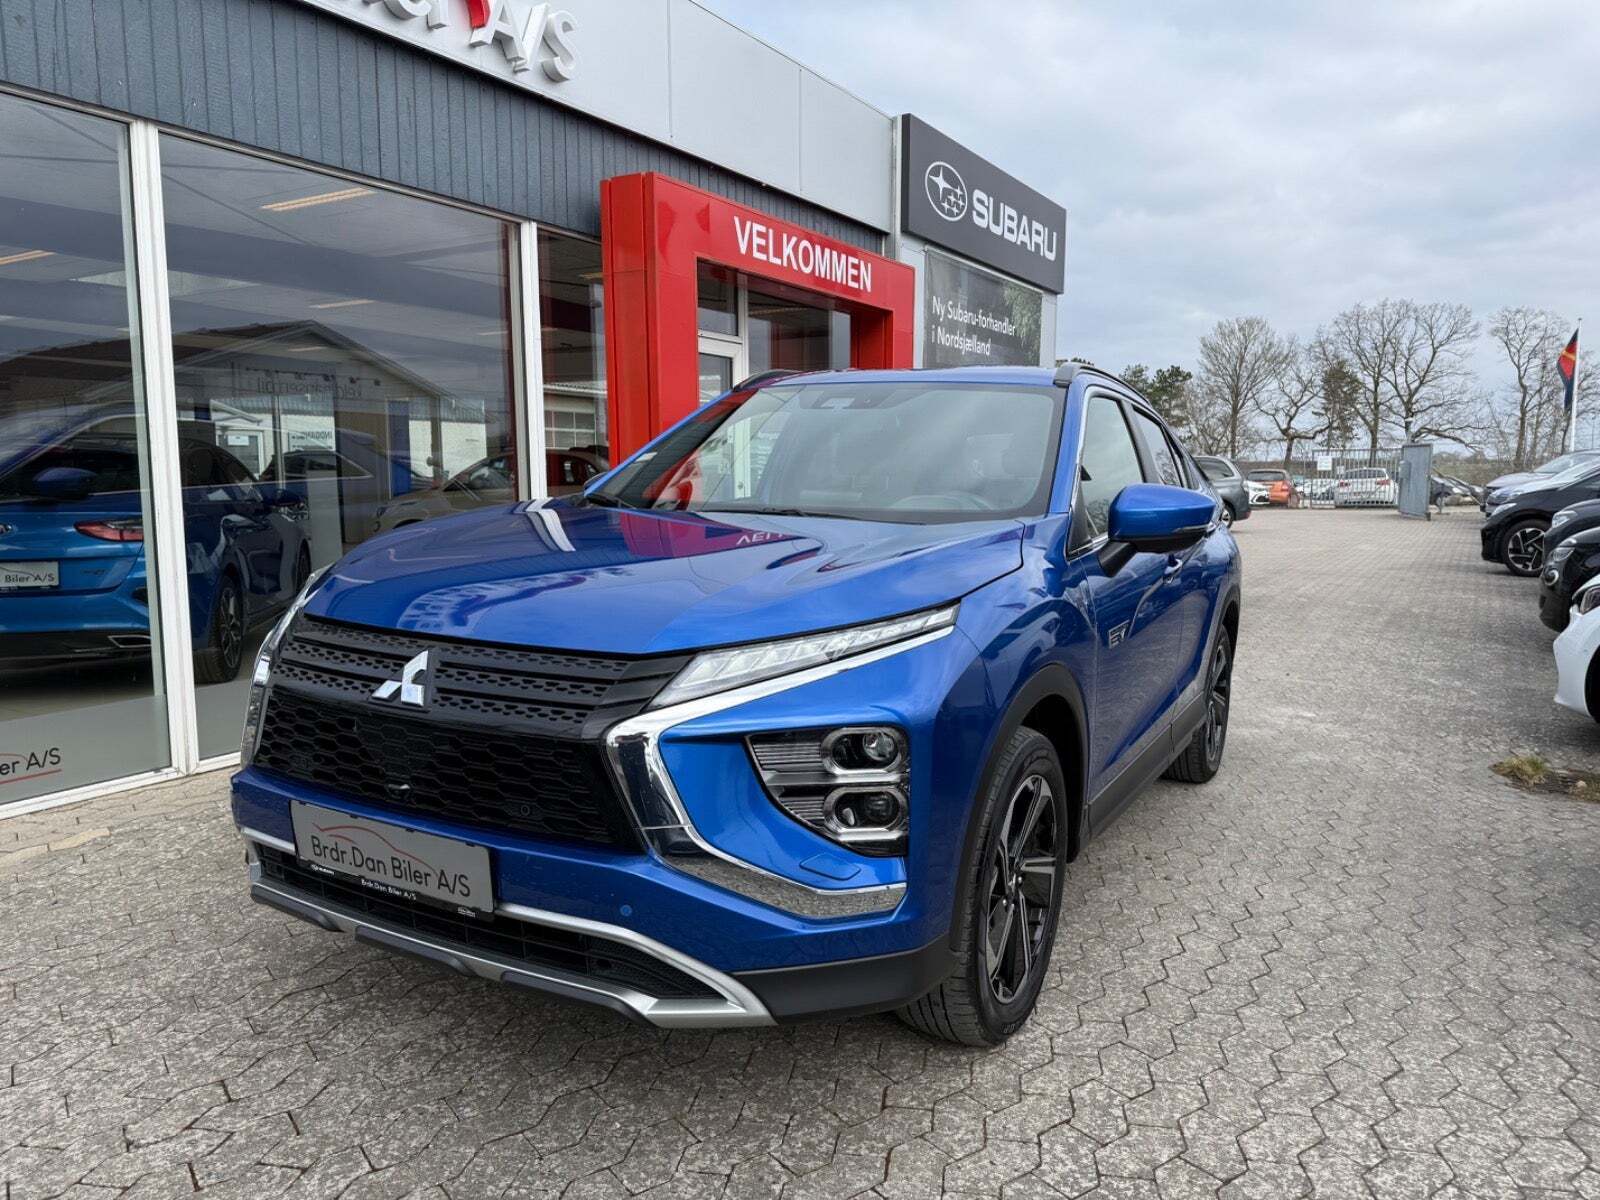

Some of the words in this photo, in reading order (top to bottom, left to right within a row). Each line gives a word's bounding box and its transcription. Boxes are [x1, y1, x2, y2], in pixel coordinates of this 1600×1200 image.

[972, 189, 1057, 261] SUBARU
[733, 215, 872, 292] VELKOMMEN
[932, 296, 946, 322] Ny
[947, 301, 1016, 336] Subaru-forhandler
[931, 324, 936, 343] i
[937, 326, 992, 355] Nordsjælland
[4, 574, 30, 583] Biler
[34, 573, 55, 581] A/S
[26, 747, 61, 771] A/S
[311, 835, 387, 876] Brdr.Dan
[391, 856, 431, 886] Biler
[437, 869, 471, 897] A/S
